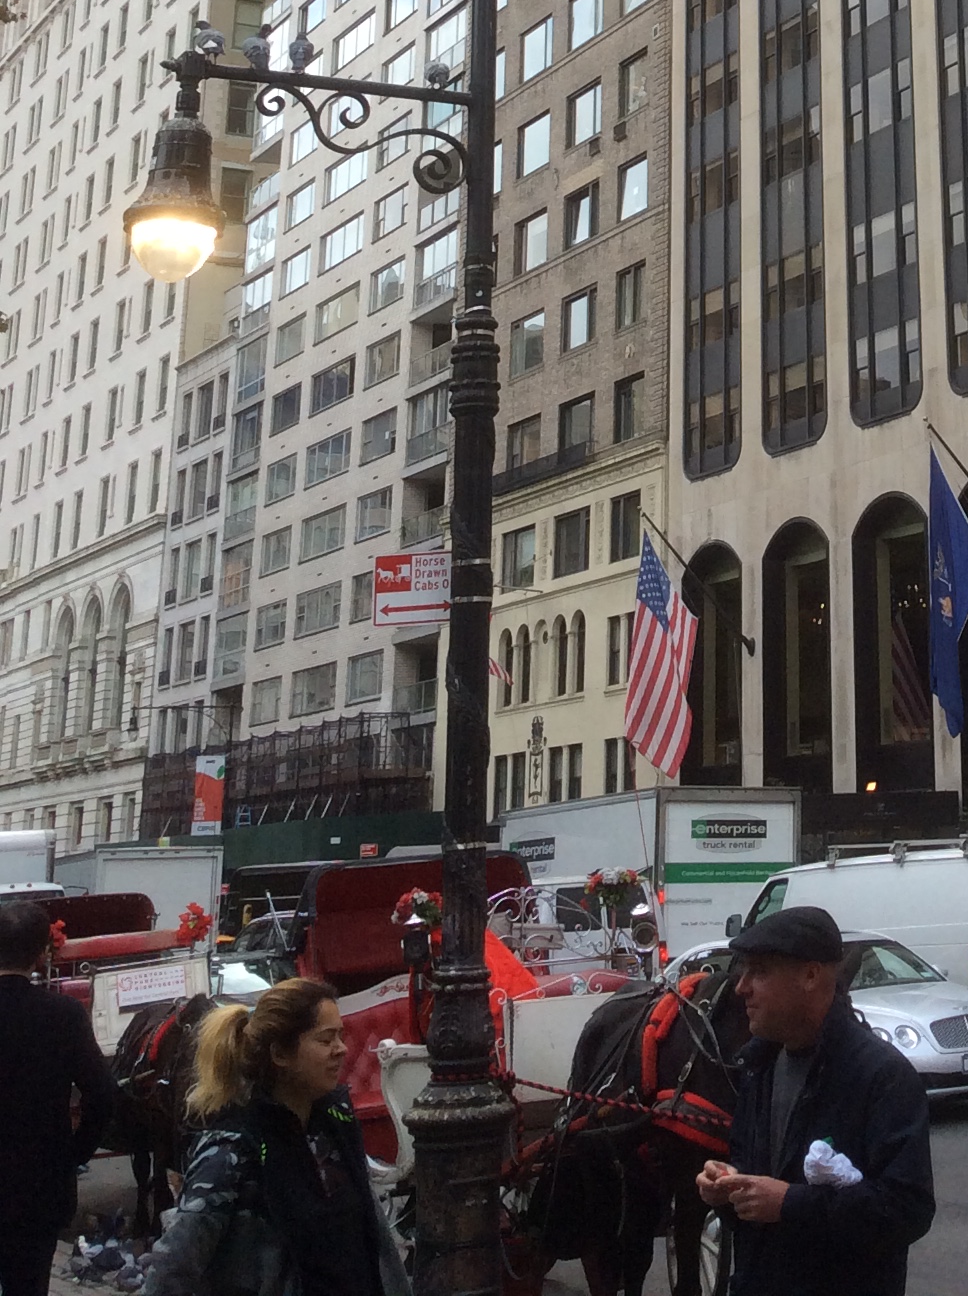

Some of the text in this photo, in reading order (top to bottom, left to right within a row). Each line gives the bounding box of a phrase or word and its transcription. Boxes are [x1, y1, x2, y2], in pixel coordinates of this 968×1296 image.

[415, 557, 446, 568] Horse
[414, 568, 447, 579] Drawn
[414, 580, 439, 591] Cabs
[693, 823, 766, 837] enterprise
[702, 840, 756, 849] truck rental
